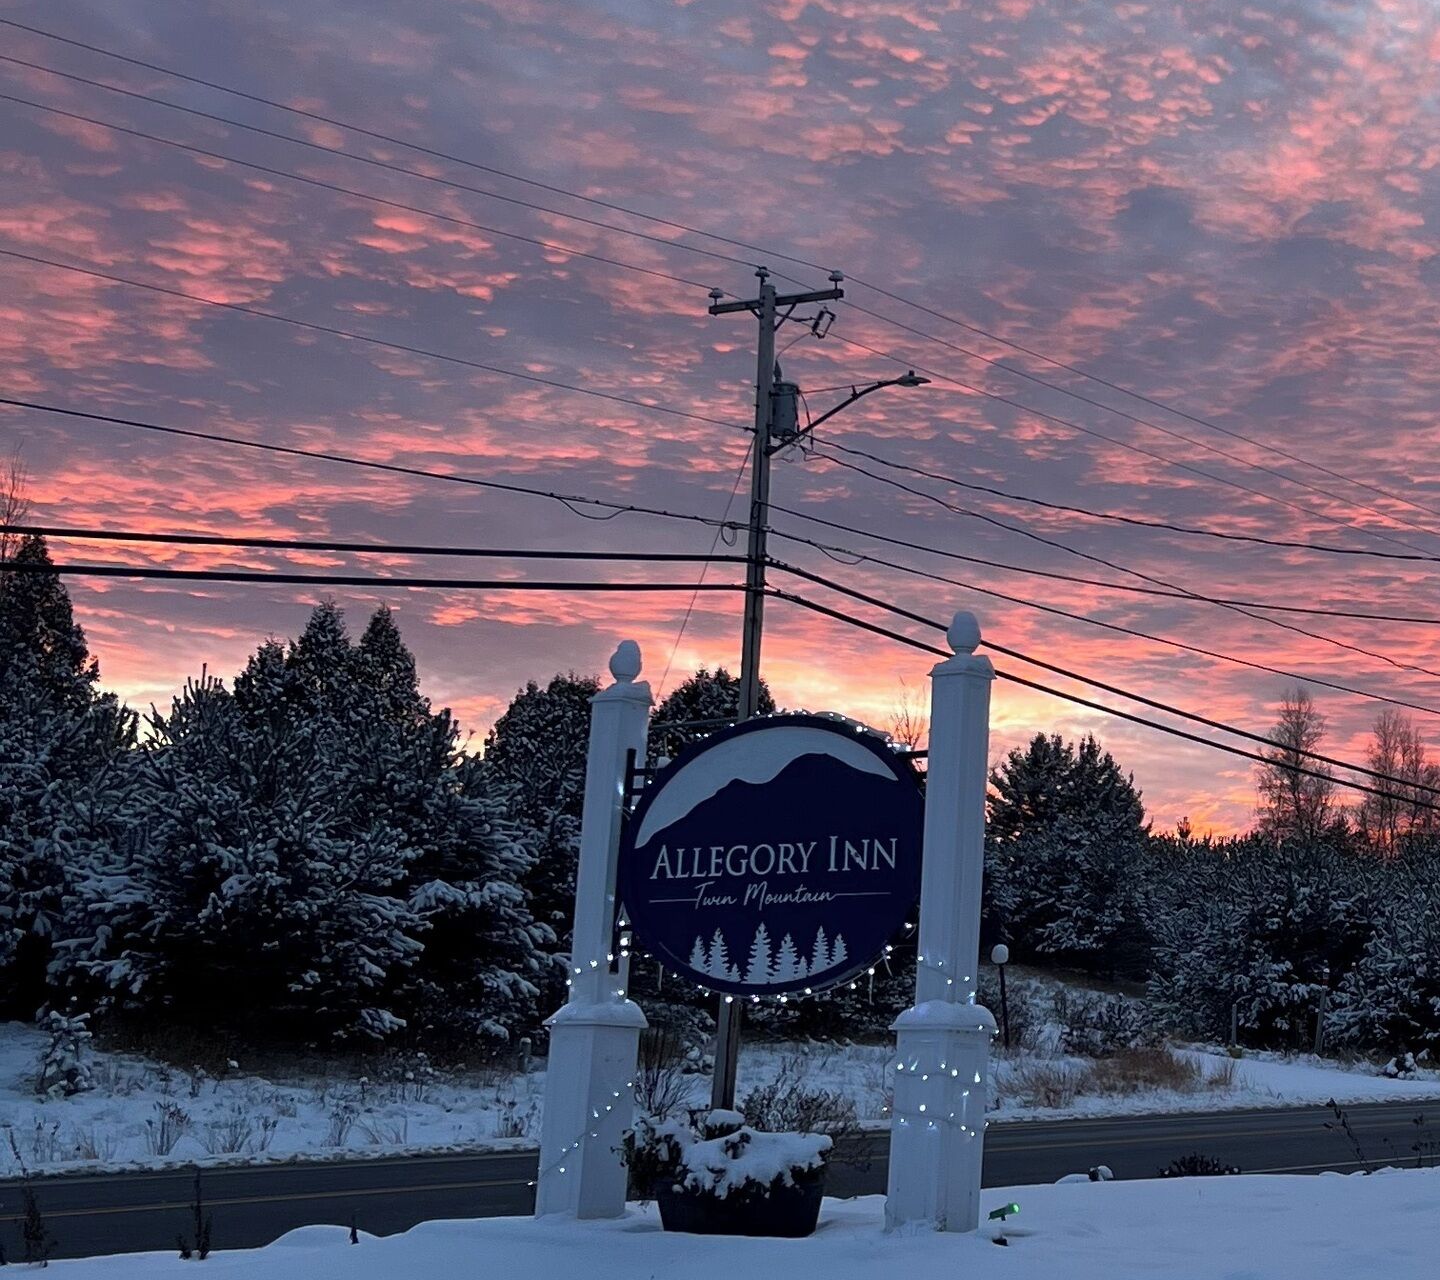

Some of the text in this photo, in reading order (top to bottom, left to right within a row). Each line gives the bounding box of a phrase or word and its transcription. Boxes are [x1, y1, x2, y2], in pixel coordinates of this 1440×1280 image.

[649, 835, 898, 879] ALLEGORY INN
[694, 881, 838, 911] Twin Mountain
